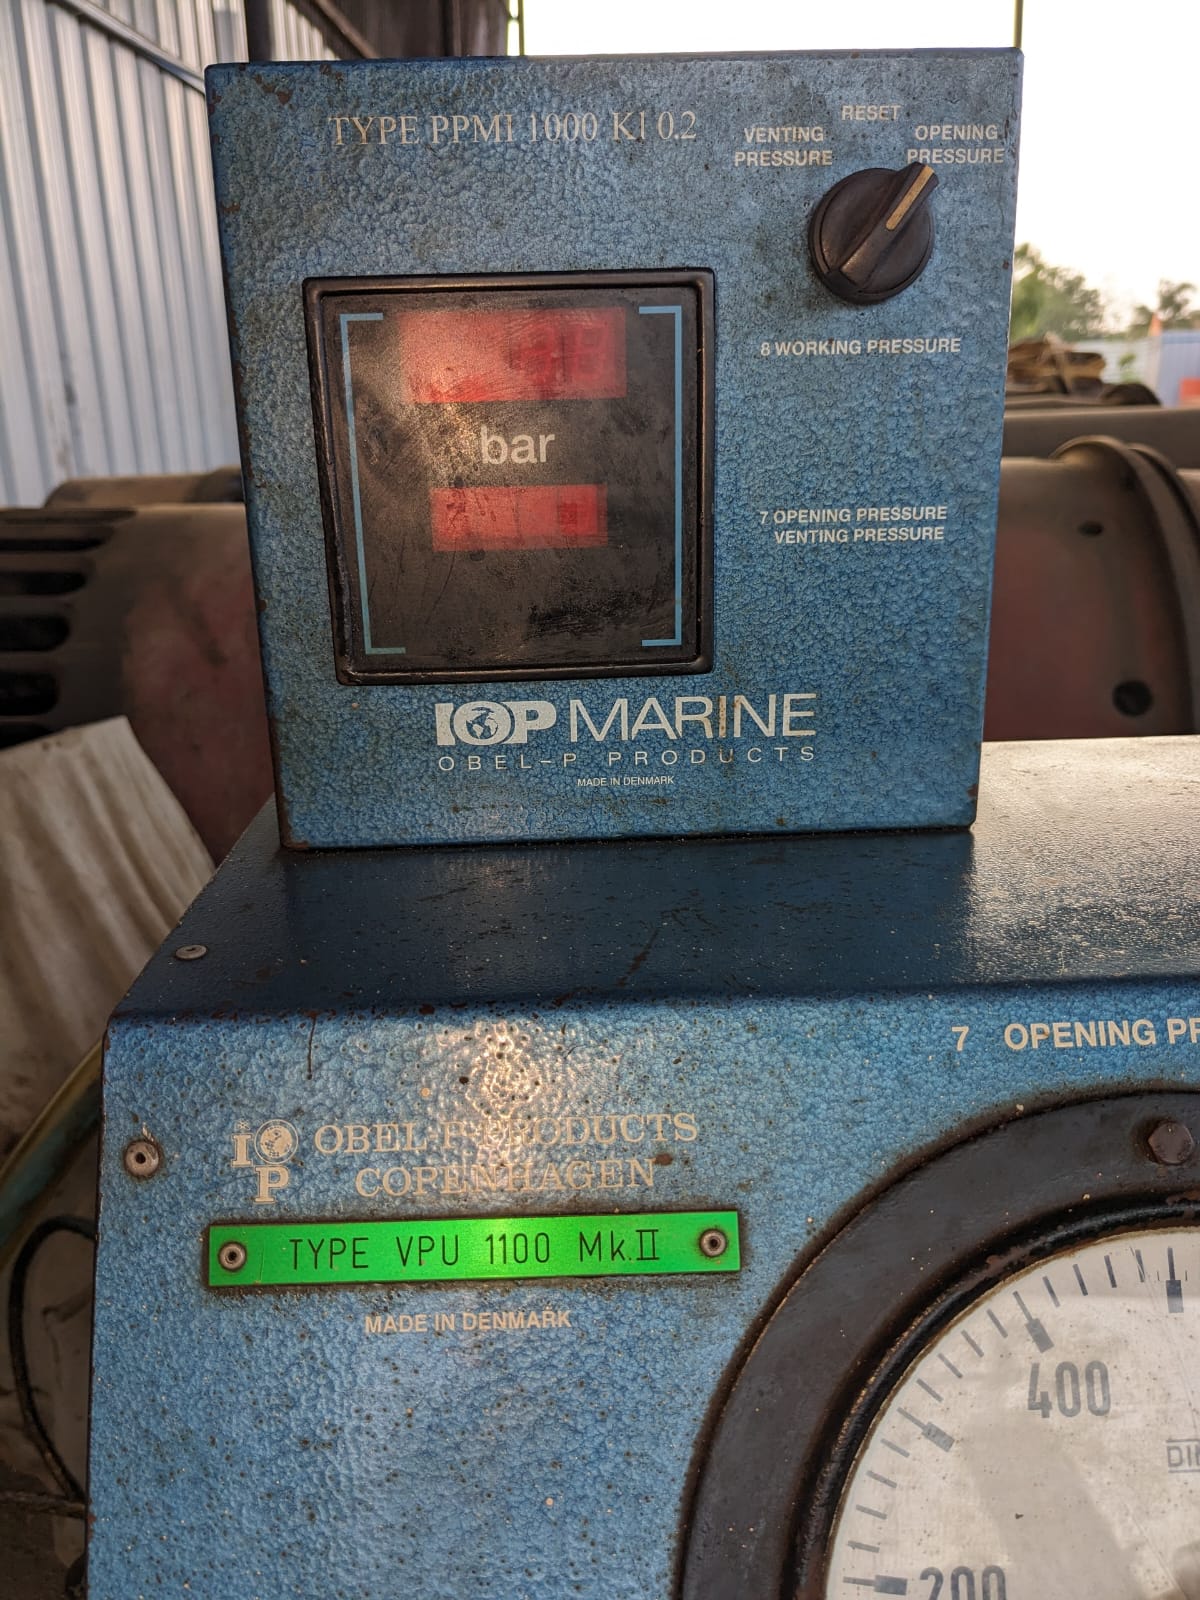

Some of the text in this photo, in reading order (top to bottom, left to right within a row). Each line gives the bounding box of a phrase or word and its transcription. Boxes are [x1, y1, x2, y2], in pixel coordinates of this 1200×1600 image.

[841, 104, 901, 121] RESET
[328, 115, 421, 146] TYPE
[431, 113, 514, 144] PPMI
[529, 111, 598, 143] 1000
[656, 109, 697, 140] 0.2
[744, 126, 825, 144] VENTING
[915, 124, 999, 141] OPENING
[734, 150, 834, 167] PRESSURE
[907, 147, 1005, 165] PRESSURE
[760, 337, 962, 357] 8 WORKING PRESSURE
[480, 424, 556, 465] bar
[760, 505, 948, 525] 7 OPENING PRESSURE
[774, 526, 945, 545] VENTING PRESSURE
[570, 692, 817, 743] MARINE
[438, 746, 815, 772] OBEL-P PRODUCTS
[577, 775, 675, 787] MADE IN DENMARK
[951, 1025, 970, 1051] 7
[1004, 1018, 1157, 1051] OPENING
[479, 1112, 698, 1147] PRODUCTS
[355, 1157, 656, 1198] COPENHAGEN
[289, 1236, 370, 1271] TYPE
[396, 1234, 460, 1268] VPU
[485, 1232, 551, 1265] 1100
[364, 1309, 573, 1335] MADE IN DENMARK
[1027, 1360, 1112, 1419] 400
[919, 1565, 1007, 1600] 200
